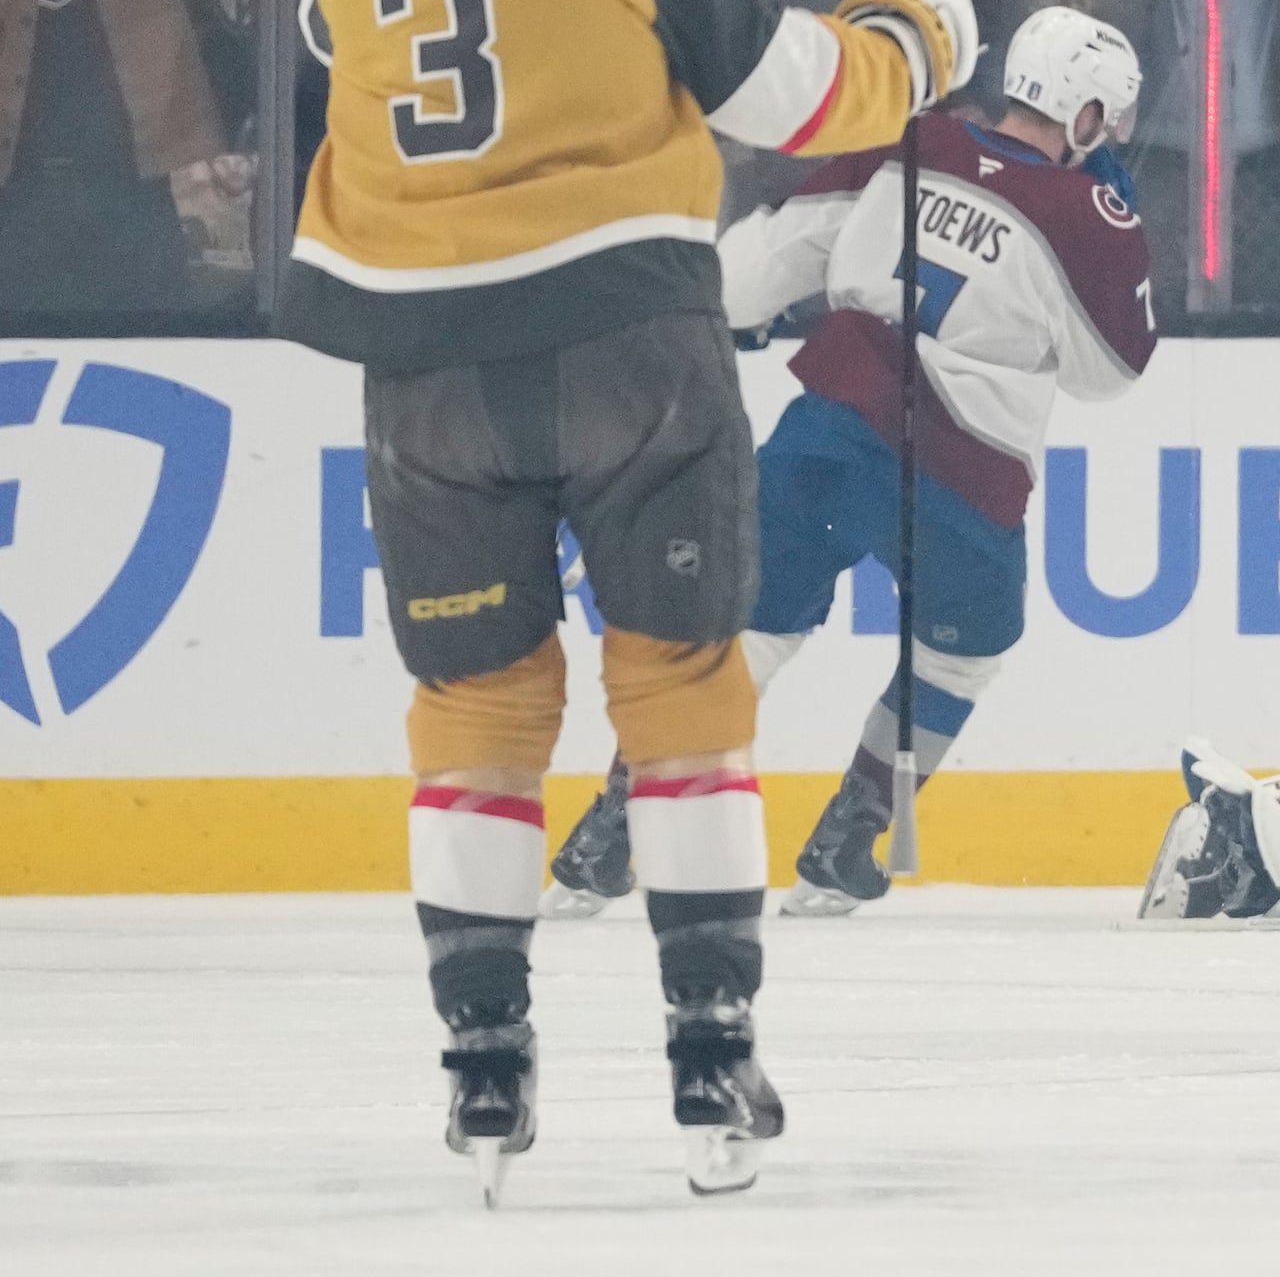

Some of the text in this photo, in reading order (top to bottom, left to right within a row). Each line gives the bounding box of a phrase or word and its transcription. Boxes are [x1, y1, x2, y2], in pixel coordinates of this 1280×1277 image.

[916, 187, 1012, 265] TOEWS
[892, 247, 968, 339] 7
[407, 582, 507, 621] CCM
